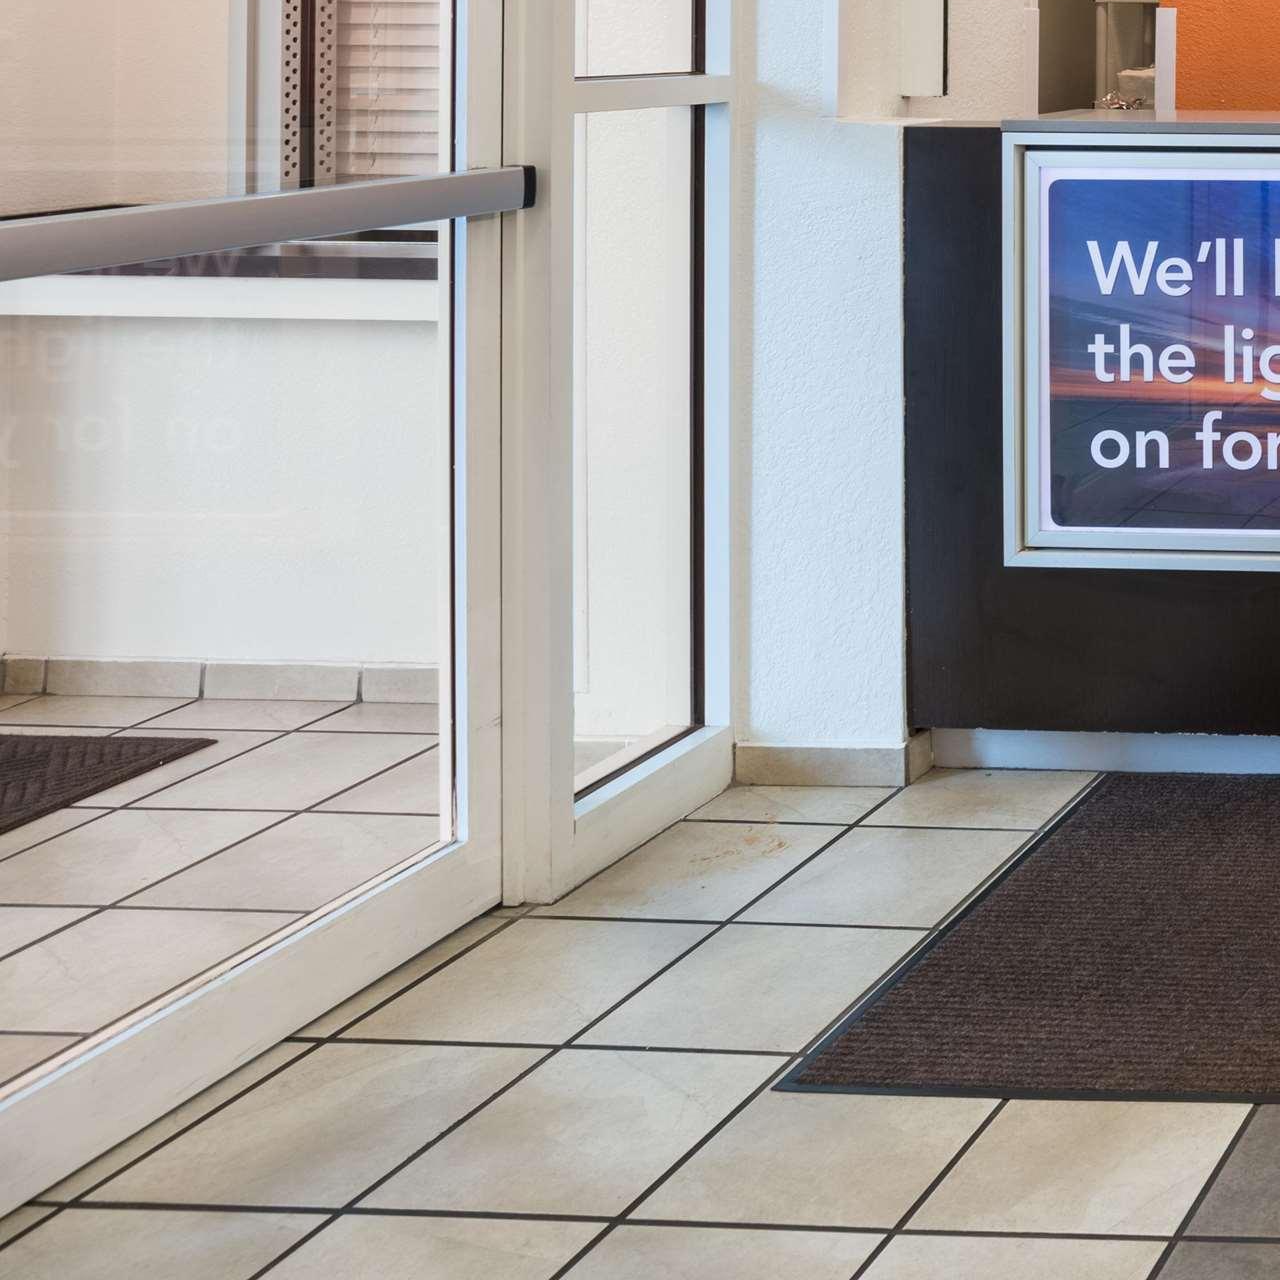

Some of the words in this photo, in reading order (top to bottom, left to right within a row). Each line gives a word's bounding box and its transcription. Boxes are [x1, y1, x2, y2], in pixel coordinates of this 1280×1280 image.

[1087, 238, 1245, 297] We'll
[1087, 323, 1196, 384] the
[1090, 428, 1170, 470] on
